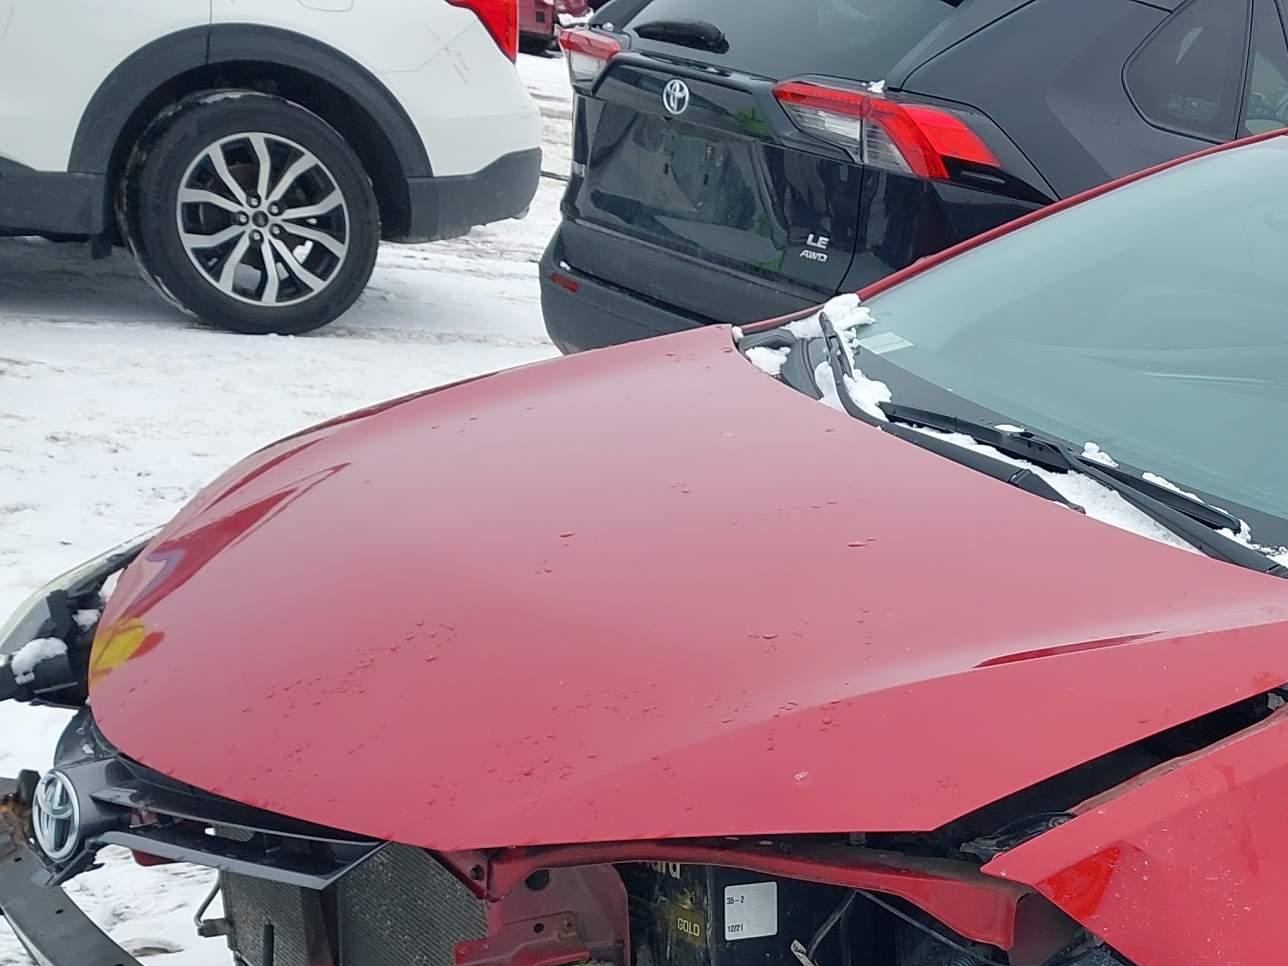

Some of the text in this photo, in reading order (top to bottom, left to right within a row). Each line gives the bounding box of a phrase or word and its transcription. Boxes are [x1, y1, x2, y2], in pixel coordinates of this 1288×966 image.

[806, 233, 830, 249] LE
[799, 249, 828, 262] AWD
[677, 917, 700, 937] GOLD
[727, 924, 743, 933] 12/21
